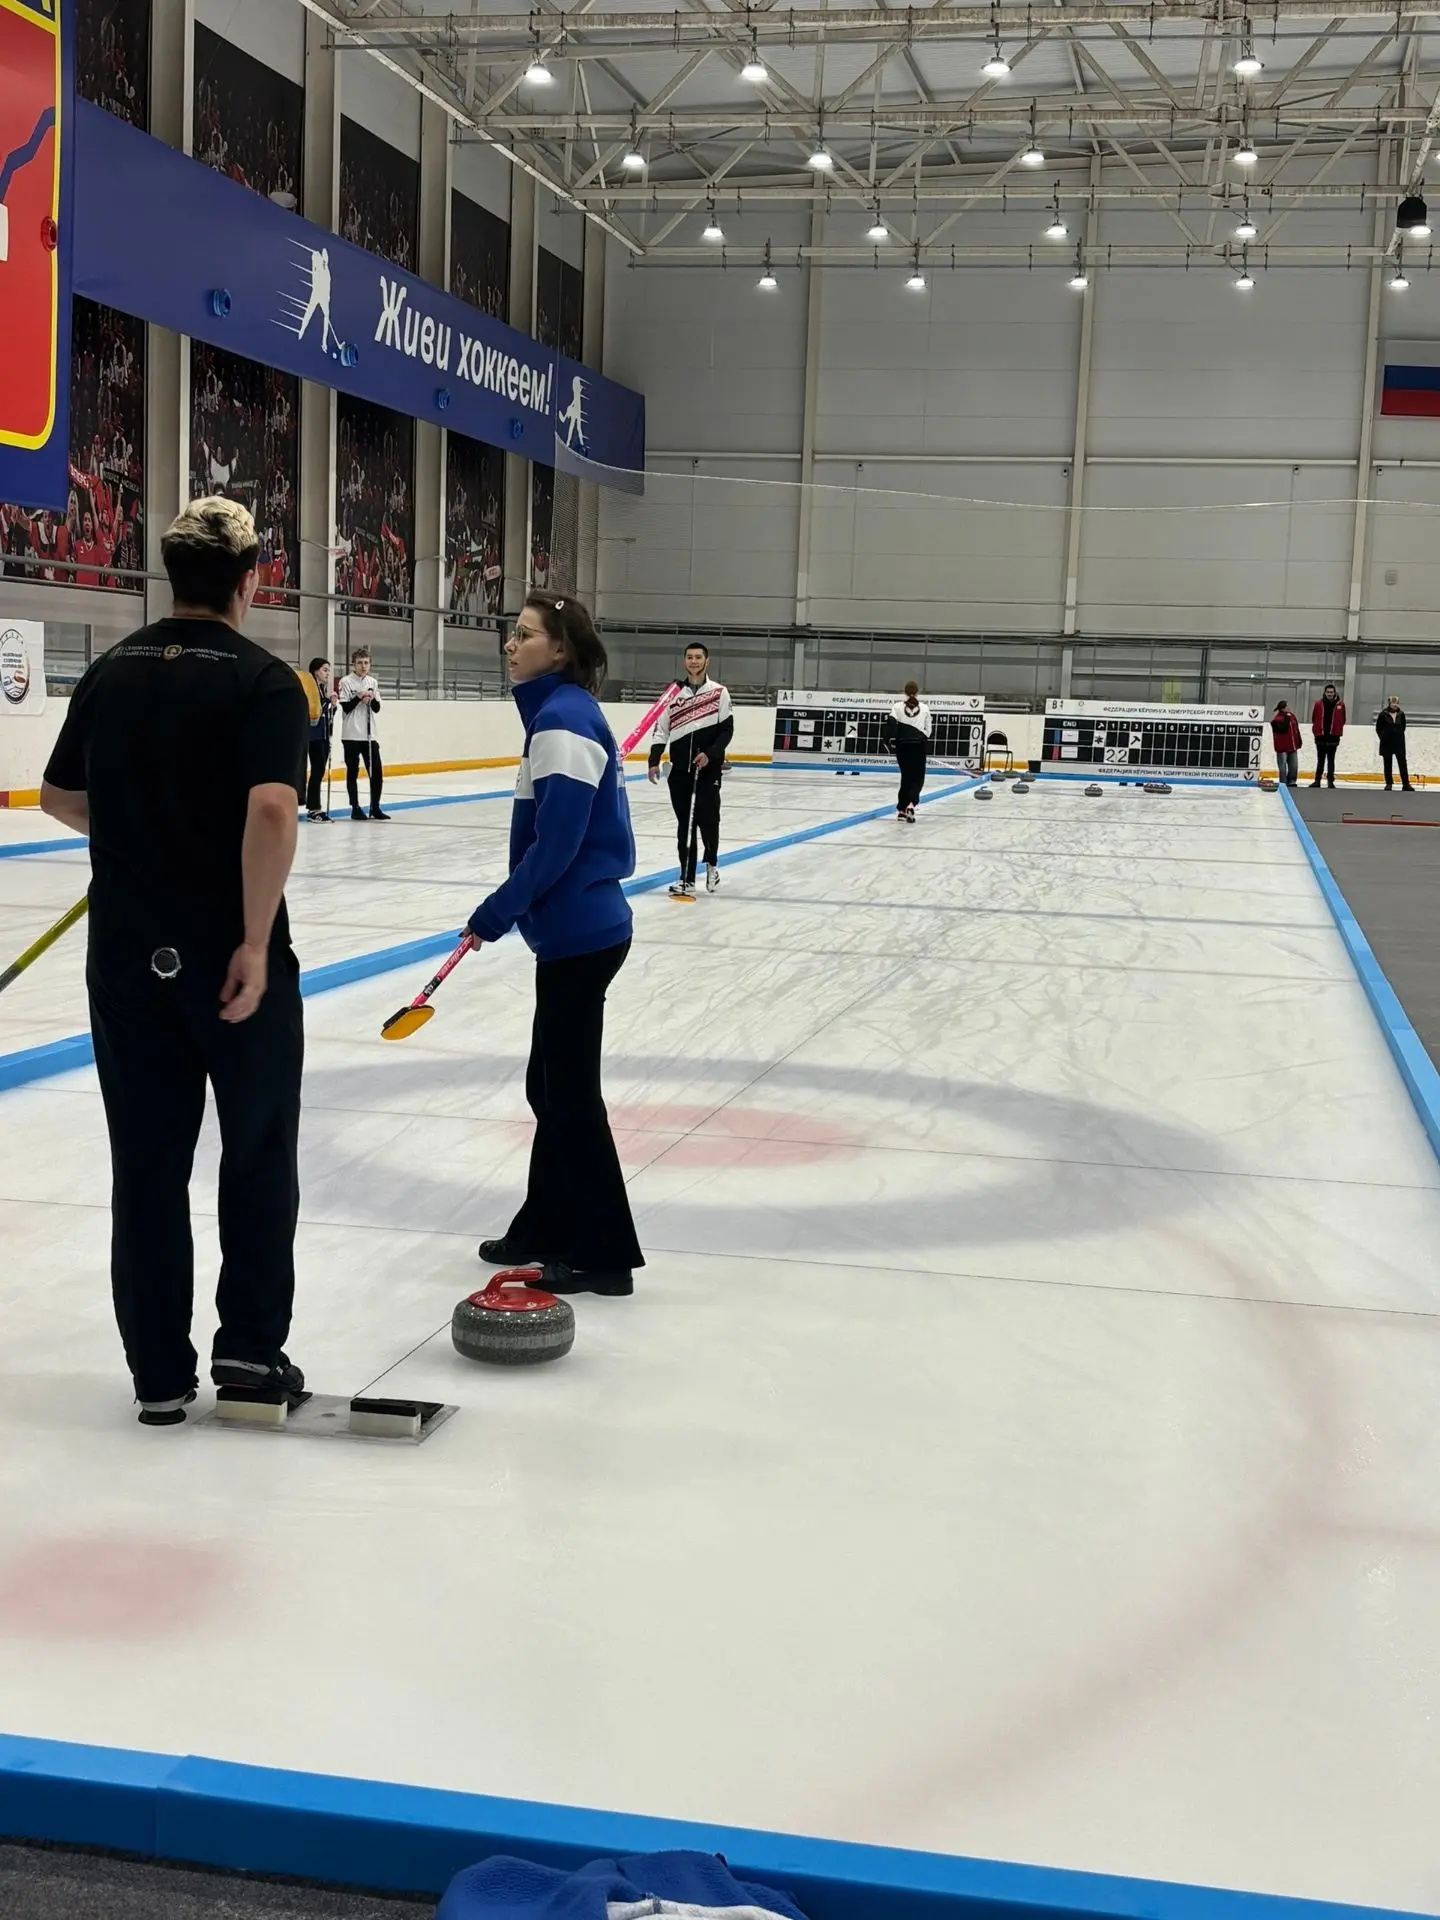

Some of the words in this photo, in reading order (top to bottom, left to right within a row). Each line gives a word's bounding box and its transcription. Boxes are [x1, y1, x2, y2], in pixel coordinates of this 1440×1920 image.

[374, 275, 451, 371] Живи
[456, 332, 554, 416] хоккеем!
[972, 726, 980, 740] 0
[836, 739, 842, 752] 1
[973, 742, 978, 755] 1
[1252, 738, 1260, 751] 0
[1250, 754, 1259, 767] 4
